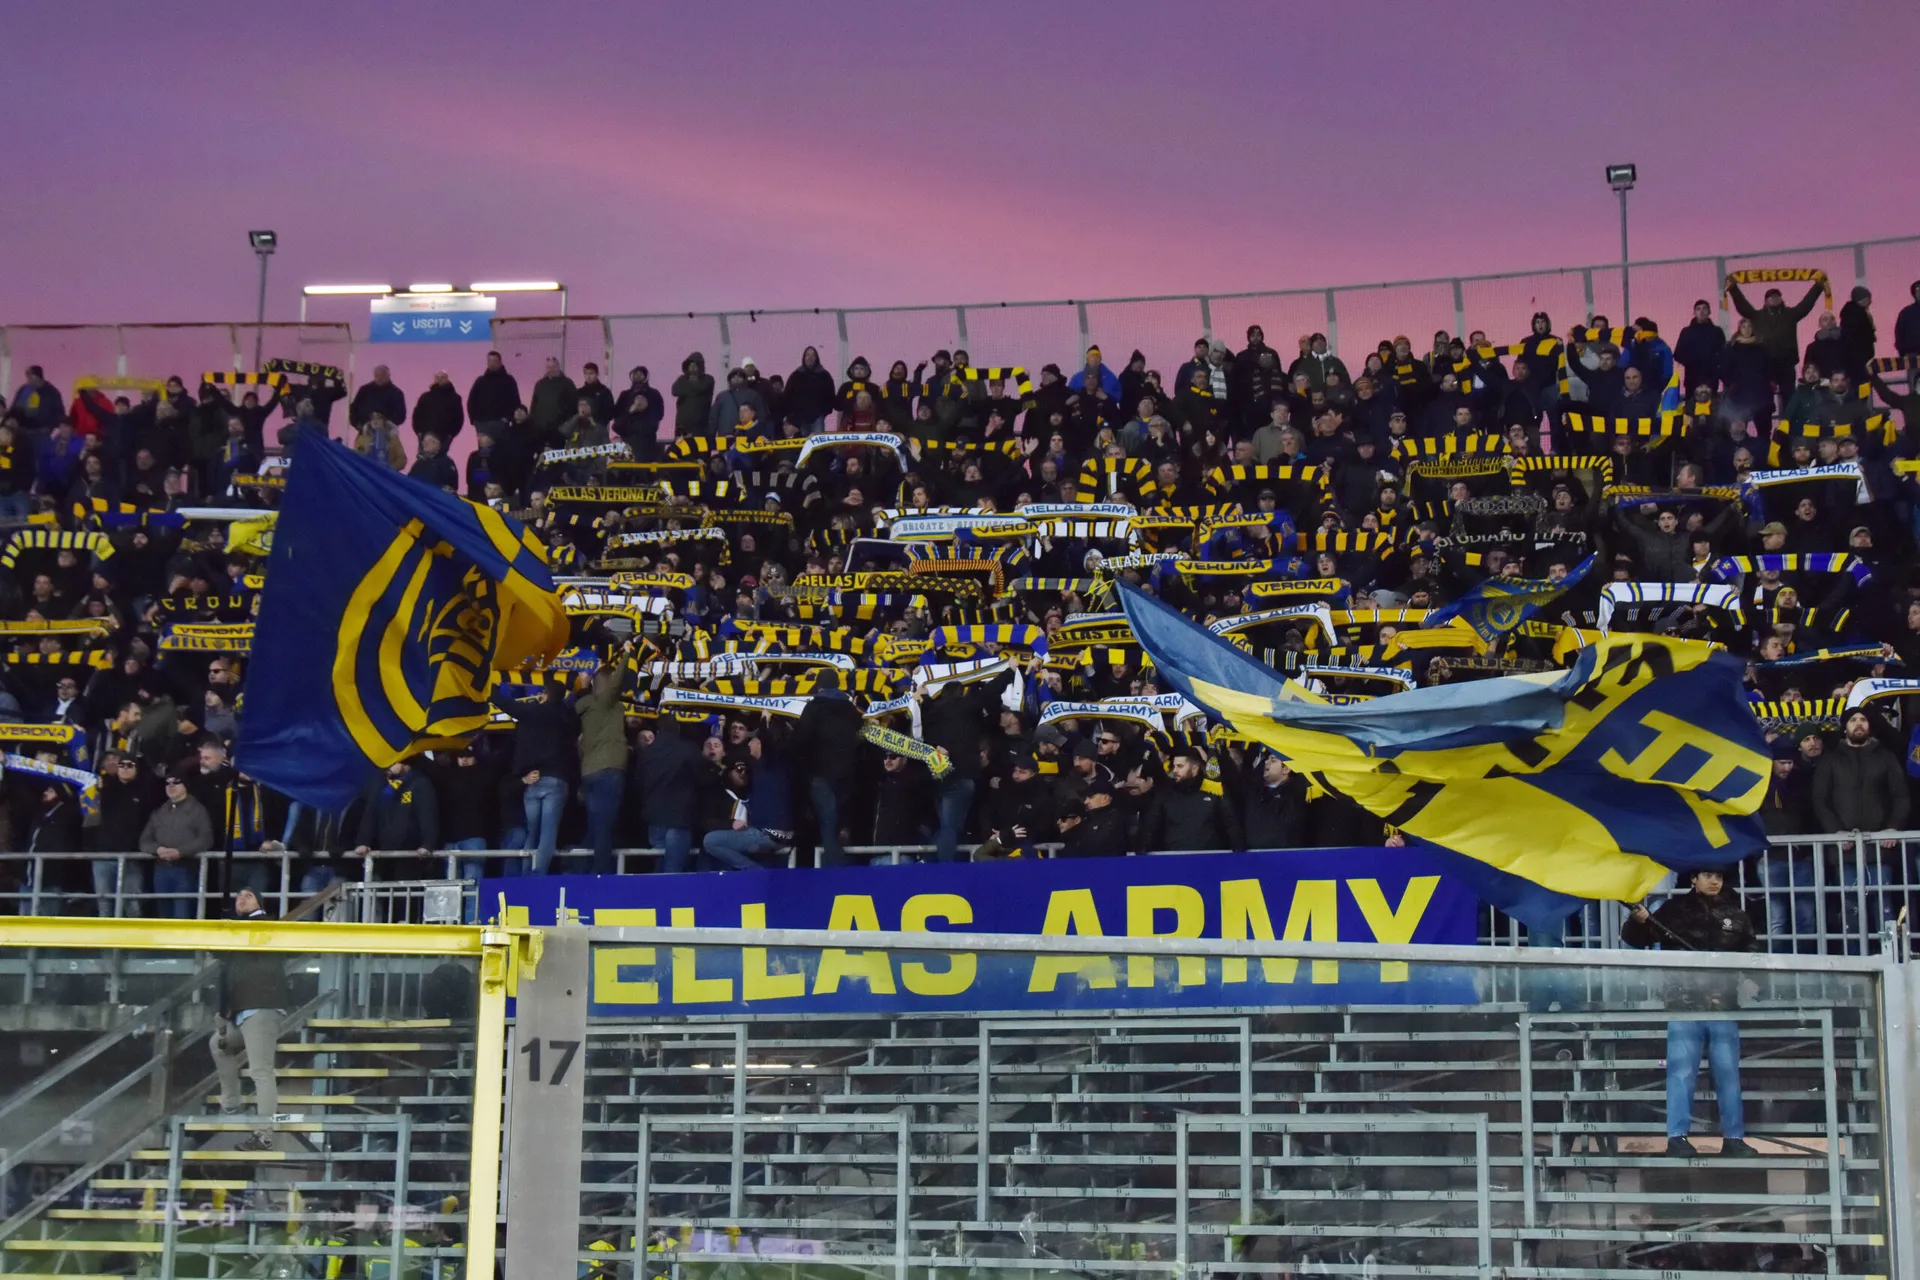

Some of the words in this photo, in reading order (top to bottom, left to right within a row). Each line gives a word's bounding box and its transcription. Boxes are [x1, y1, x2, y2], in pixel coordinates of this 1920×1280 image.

[1734, 268, 1825, 283] VERONA
[412, 318, 452, 330] USCITA
[811, 435, 859, 445] HELLAS
[866, 434, 899, 446] ARMY
[1751, 469, 1809, 481] HELLAS
[1815, 464, 1859, 475] ARMY
[552, 488, 596, 500] HELLAS
[599, 488, 644, 501] VERONA
[1024, 504, 1083, 515] HELLAS
[903, 521, 944, 532] BRIGATE
[1131, 516, 1196, 526] VERON
[977, 522, 1040, 534] VERON
[1180, 560, 1266, 572] VERONA
[614, 573, 686, 586] VERONA
[800, 575, 853, 588] HELLAS
[1257, 581, 1335, 593] VERONA
[161, 597, 242, 611] ERON
[1210, 614, 1262, 633] ELLAS
[1268, 603, 1321, 617] ARMY
[537, 655, 594, 670] VRONA
[676, 691, 736, 704] HELLAS
[742, 697, 791, 709] ARMY
[1154, 695, 1185, 706] ARM
[1042, 703, 1099, 718] HELLAS
[1107, 704, 1159, 718] ARMY
[1027, 875, 1442, 994] ARMY
[520, 1036, 581, 1086] 17
